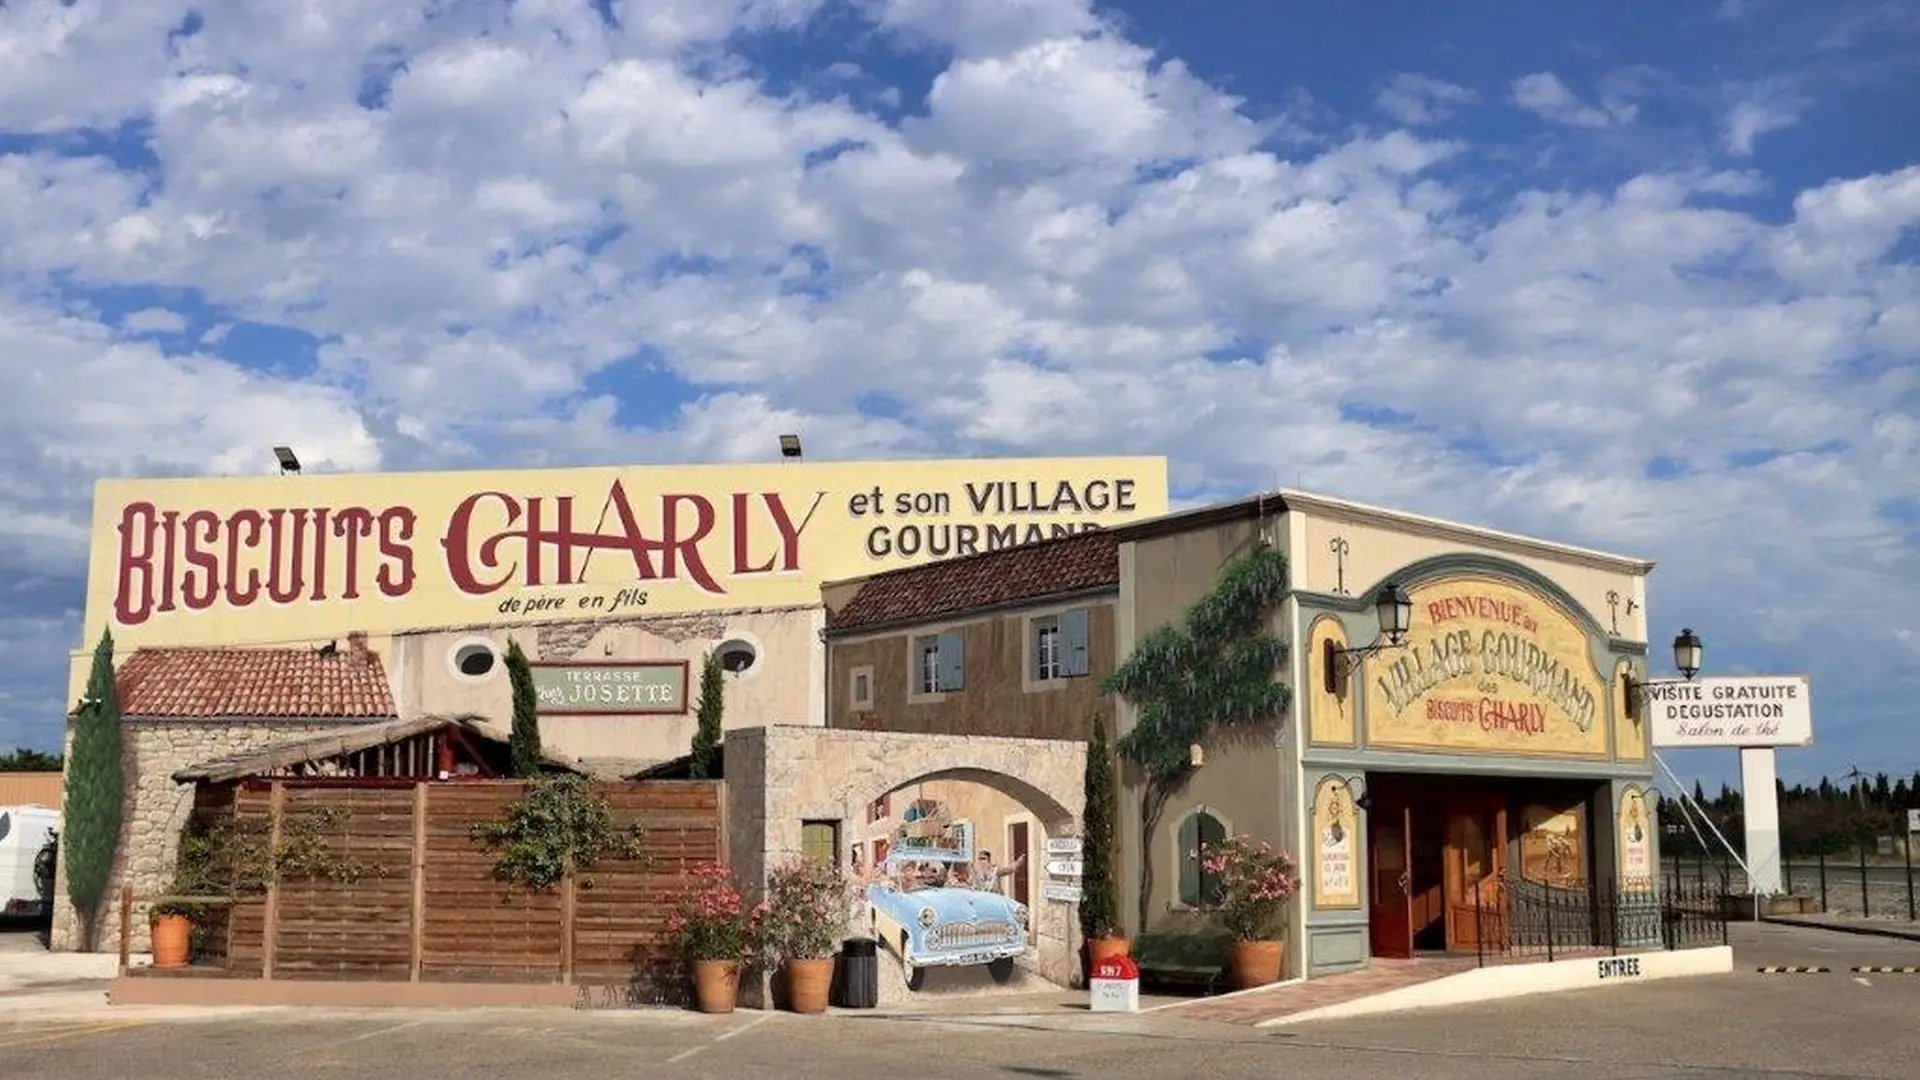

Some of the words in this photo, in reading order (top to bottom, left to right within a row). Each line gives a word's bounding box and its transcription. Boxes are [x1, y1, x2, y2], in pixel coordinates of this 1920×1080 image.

[850, 486, 884, 515] et
[896, 491, 951, 513] son
[965, 479, 1137, 513] VILLAGE
[113, 501, 418, 625] BISCUITS
[439, 478, 829, 595] CHARLY
[499, 596, 521, 613] de
[523, 594, 566, 615] père
[579, 595, 604, 609] en
[608, 588, 649, 612] fils
[1428, 596, 1521, 626] BIENVENUE
[565, 671, 641, 682] TERRASSE
[1378, 630, 1472, 718] VILLAGE
[1479, 630, 1595, 733] GOURMAND
[569, 683, 673, 703] JOSETTE
[1651, 686, 1702, 701] VISITE
[1712, 685, 1797, 700] GRATUITE
[1426, 698, 1475, 722] BISCUITS
[1478, 696, 1548, 736] CHARLY
[1666, 703, 1784, 719] DEGUSTATION
[1677, 721, 1724, 737] Salon
[1731, 723, 1751, 737] de
[1599, 958, 1640, 978] ENTREE
